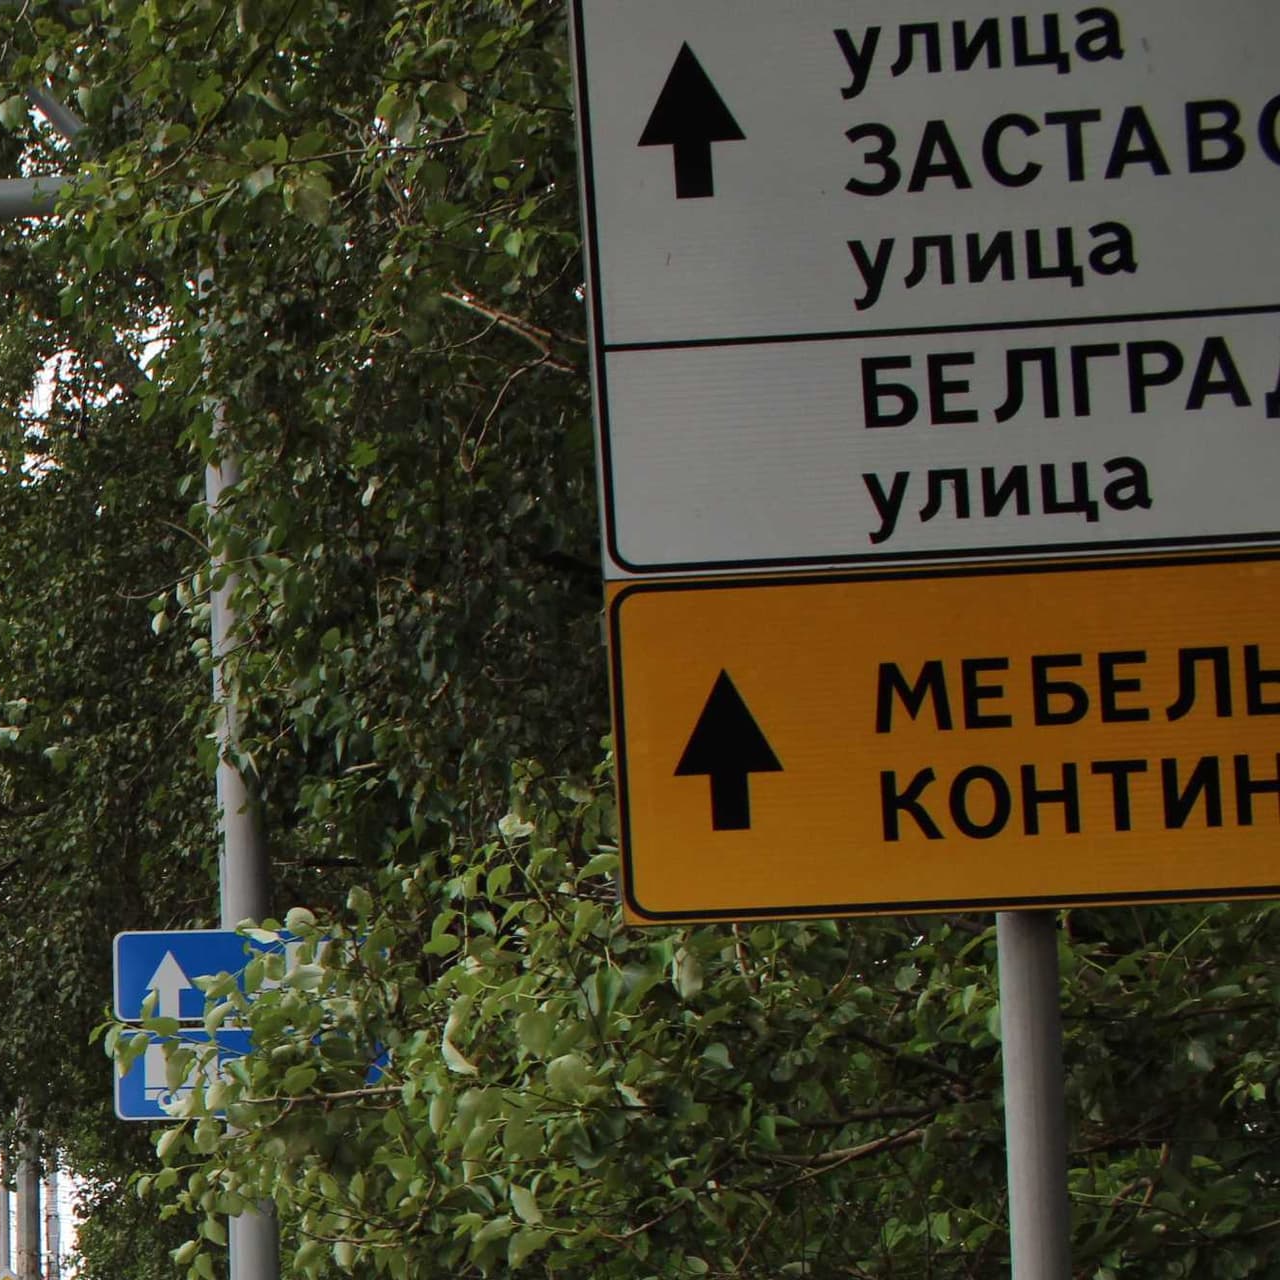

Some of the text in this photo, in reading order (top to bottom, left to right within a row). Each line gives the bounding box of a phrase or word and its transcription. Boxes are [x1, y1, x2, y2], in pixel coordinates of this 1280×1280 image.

[833, 6, 1125, 100] улица
[846, 221, 1138, 311] улица
[860, 335, 1280, 429] БЕЛГРА
[861, 456, 1153, 545] улица
